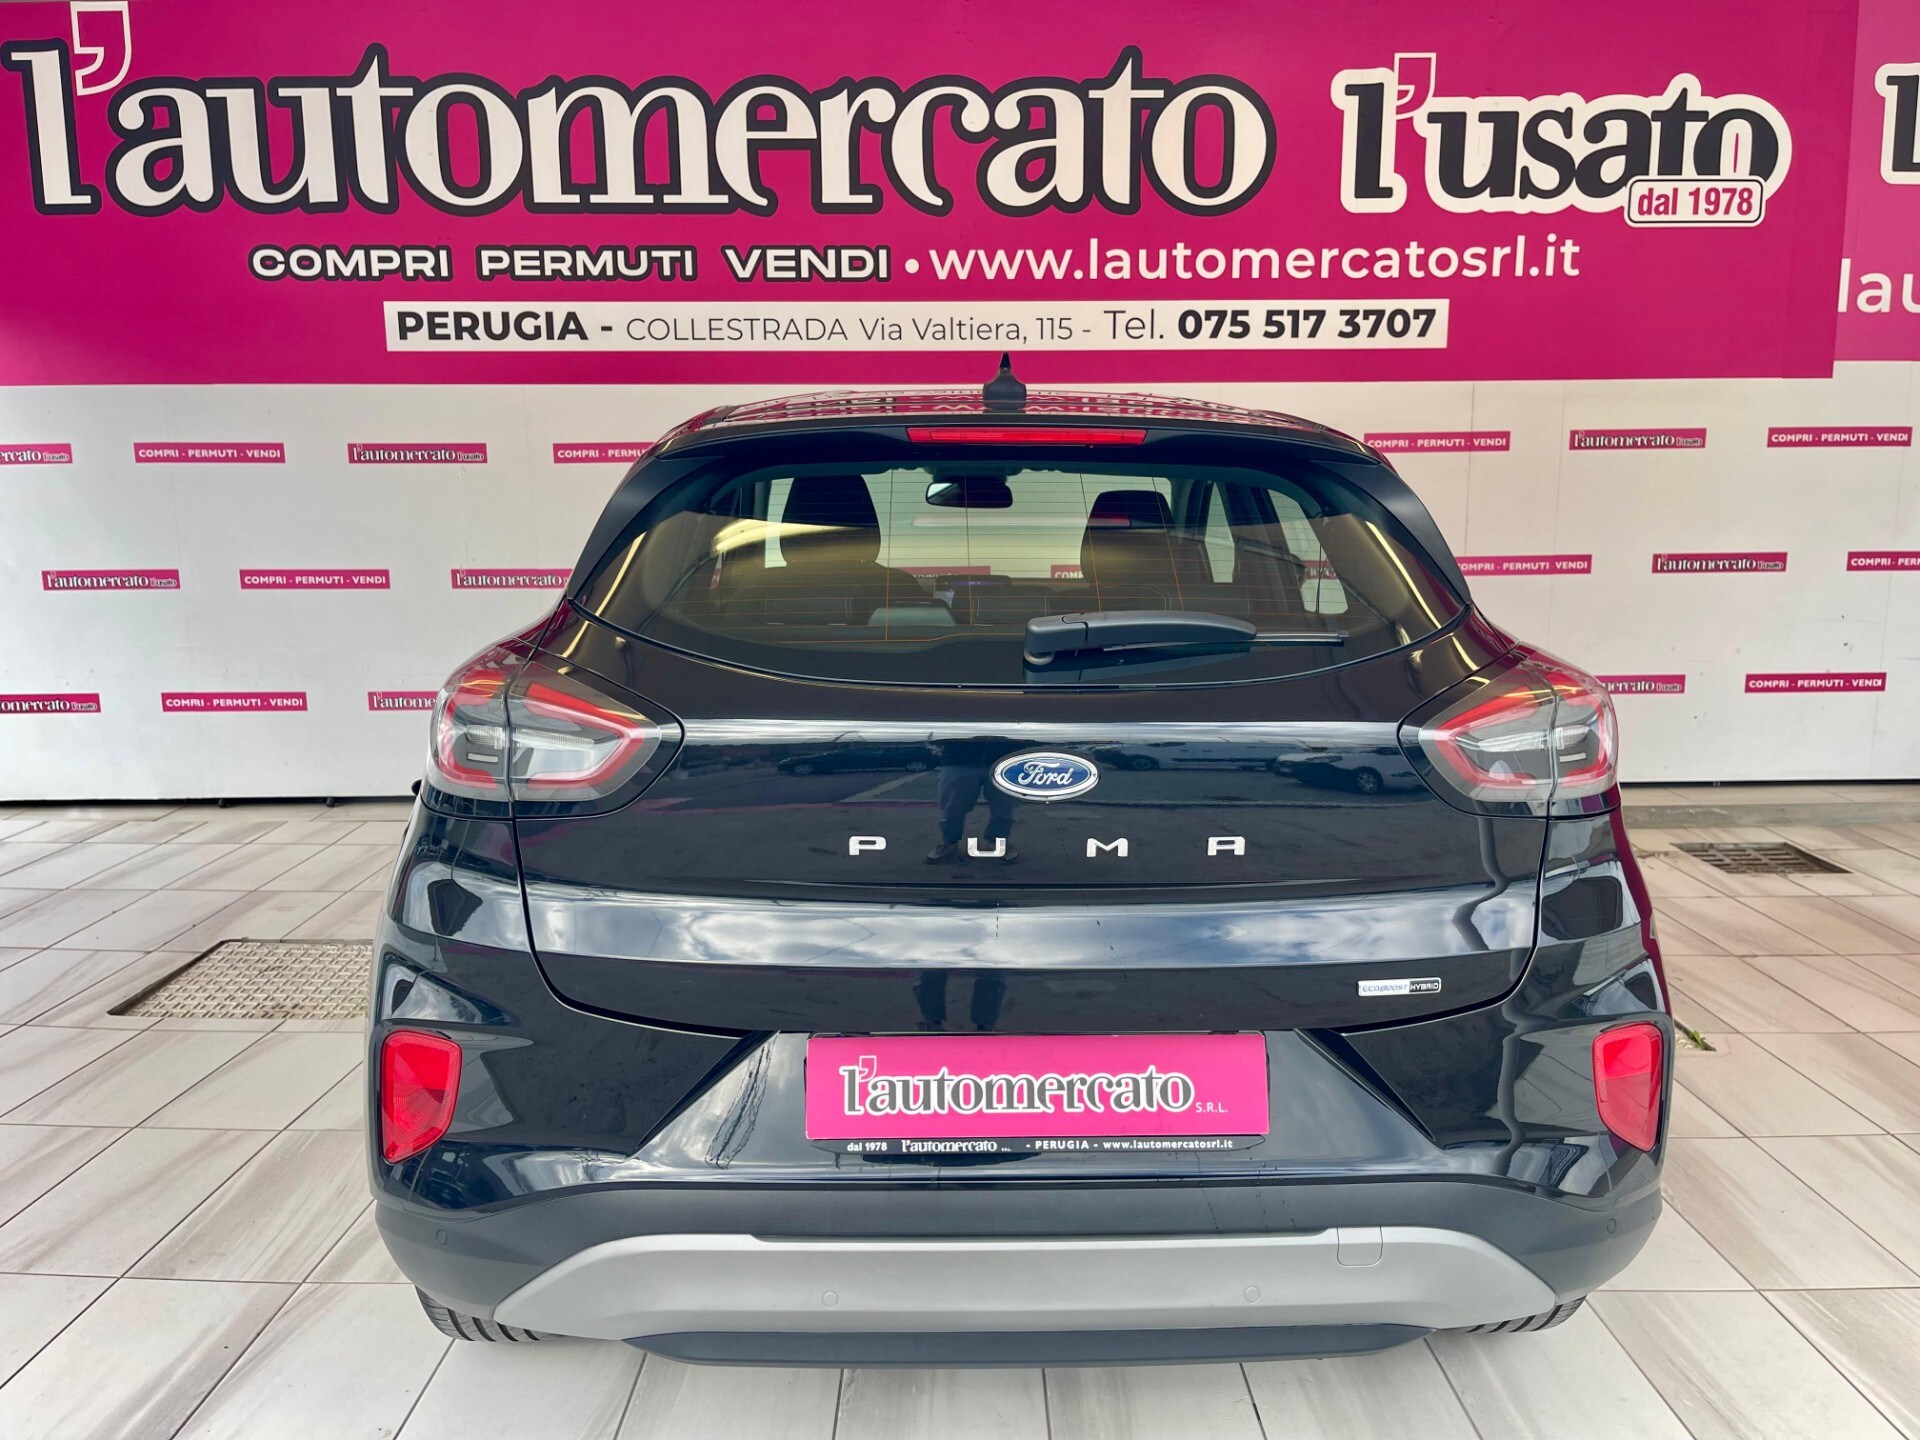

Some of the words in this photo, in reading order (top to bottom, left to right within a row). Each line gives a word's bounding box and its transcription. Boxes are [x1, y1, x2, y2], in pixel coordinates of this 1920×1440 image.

[3, 0, 1277, 217] l'automercato
[1330, 52, 1793, 213] l'usato
[1636, 186, 1678, 217] dal
[1687, 186, 1754, 217] 1978
[249, 244, 454, 281] COMPRI
[476, 244, 697, 282] PERMUTI
[721, 244, 892, 282] VENDI
[929, 233, 1581, 280] www.lautomercatosrl.it
[398, 310, 589, 342] PERUGIA
[625, 317, 848, 341] COLLESTRADA
[858, 315, 903, 341] Via
[911, 315, 1028, 345] Valtiera,
[1035, 316, 1073, 340] 115
[1103, 308, 1164, 339] Tel.
[1177, 309, 1250, 339] 075
[1262, 308, 1326, 339] 517
[1337, 308, 1437, 339] 3707
[1771, 433, 1813, 443] COMPRI
[1821, 433, 1869, 442] PERMUTI
[1876, 432, 1909, 441] VENDI
[1367, 439, 1409, 448] COMPRI
[1417, 438, 1465, 447] PERMUTI
[1473, 438, 1506, 447] VENDI
[138, 449, 180, 458] COMPRI
[188, 449, 238, 458] PERMUTI
[246, 449, 281, 458] VENDI
[557, 449, 599, 458] COMPRI
[1502, 562, 1550, 571] PERMUTI
[1555, 561, 1588, 570] VENDI
[1850, 557, 1892, 567] COMPRI
[244, 576, 287, 585] COMPRI
[295, 576, 345, 585] PERMUTI
[352, 575, 386, 584] VENDI
[1749, 679, 1790, 688] COMPRI
[1797, 679, 1844, 688] PERMUTI
[1851, 678, 1883, 687] VENDI
[165, 698, 205, 707] COMPRI
[213, 698, 262, 707] PERMUTI
[269, 698, 303, 706] VENDI
[1017, 760, 1075, 786] Ford
[1410, 982, 1439, 991] HYBRID
[839, 1055, 1195, 1117] l'automercato
[1195, 1102, 1229, 1113] S.R.L.
[847, 1142, 862, 1151] dal
[865, 1142, 888, 1151] 1978
[901, 1139, 998, 1152] l'automercato
[1035, 1140, 1090, 1150] PERUGIA
[1103, 1139, 1233, 1149] www.lautomercatosrl.it
